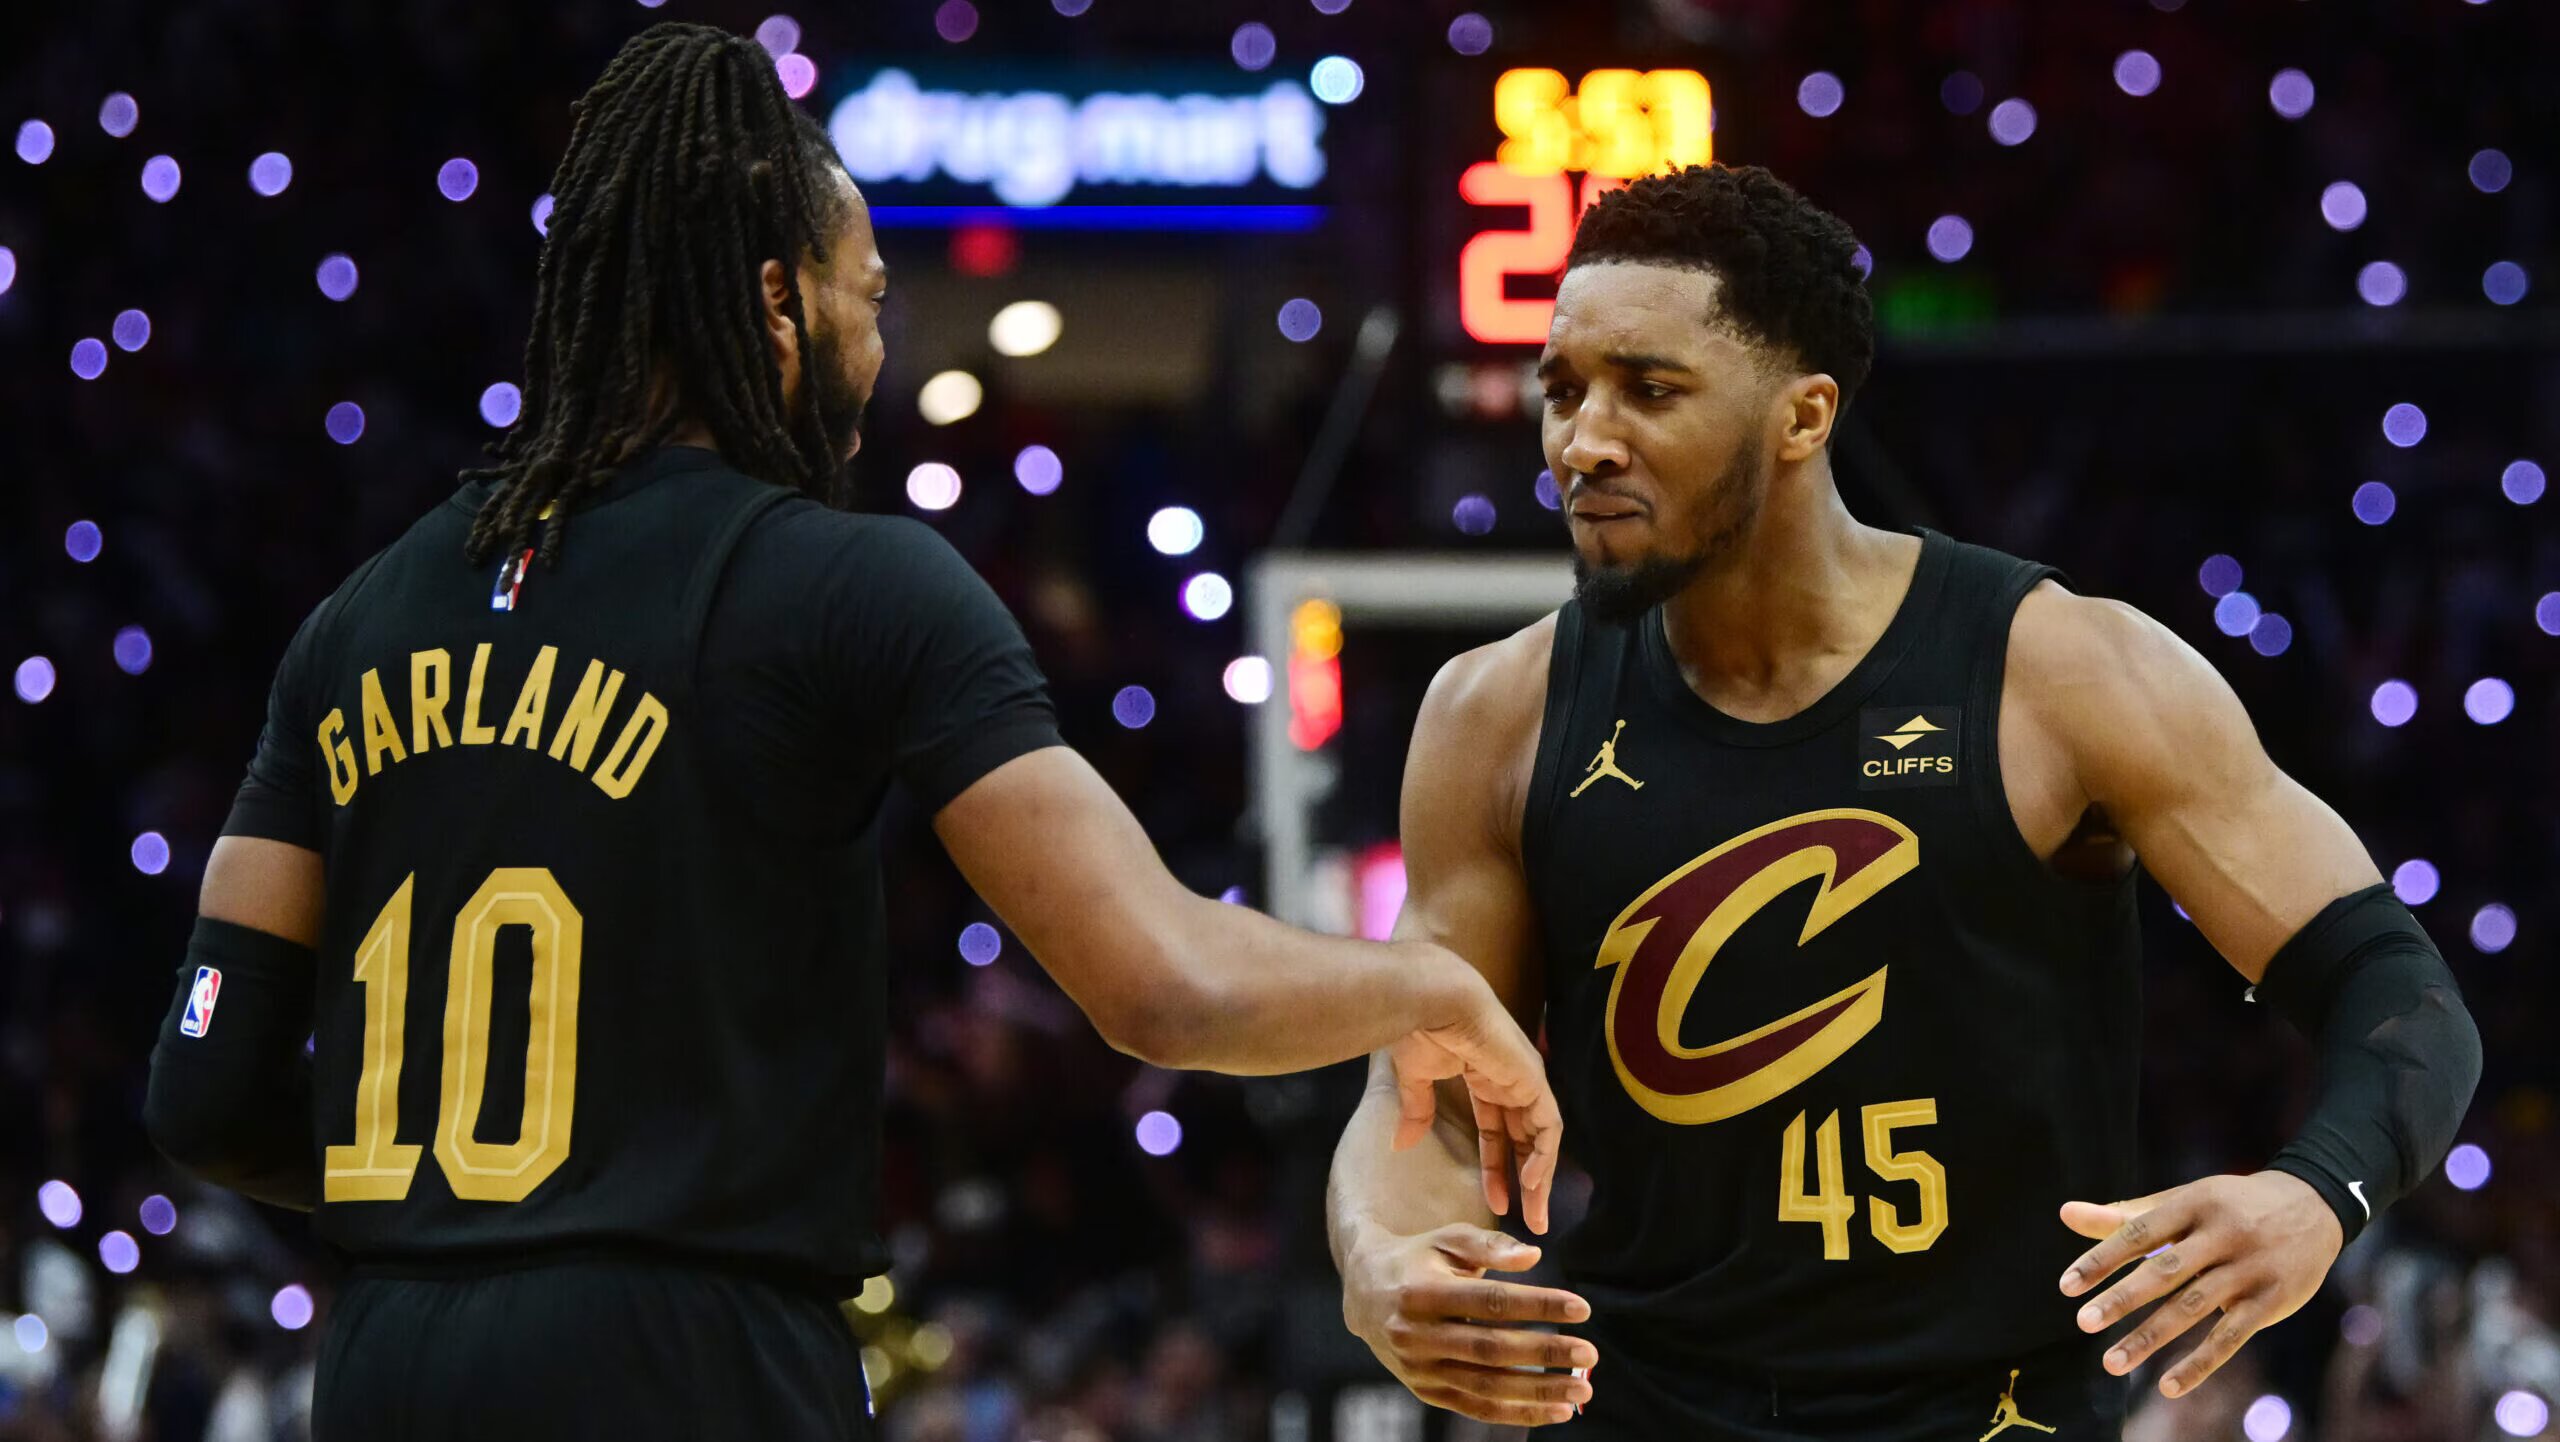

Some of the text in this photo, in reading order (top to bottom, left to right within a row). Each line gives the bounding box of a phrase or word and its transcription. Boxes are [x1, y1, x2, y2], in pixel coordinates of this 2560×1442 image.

[829, 68, 1327, 207] drug mart
[1459, 161, 1630, 344] 2
[318, 642, 669, 807] GARLAND
[1862, 756, 1954, 777] CLIFFS
[323, 867, 584, 1203] 10
[1594, 807, 1920, 1125] C
[1777, 1097, 1949, 1261] 45
